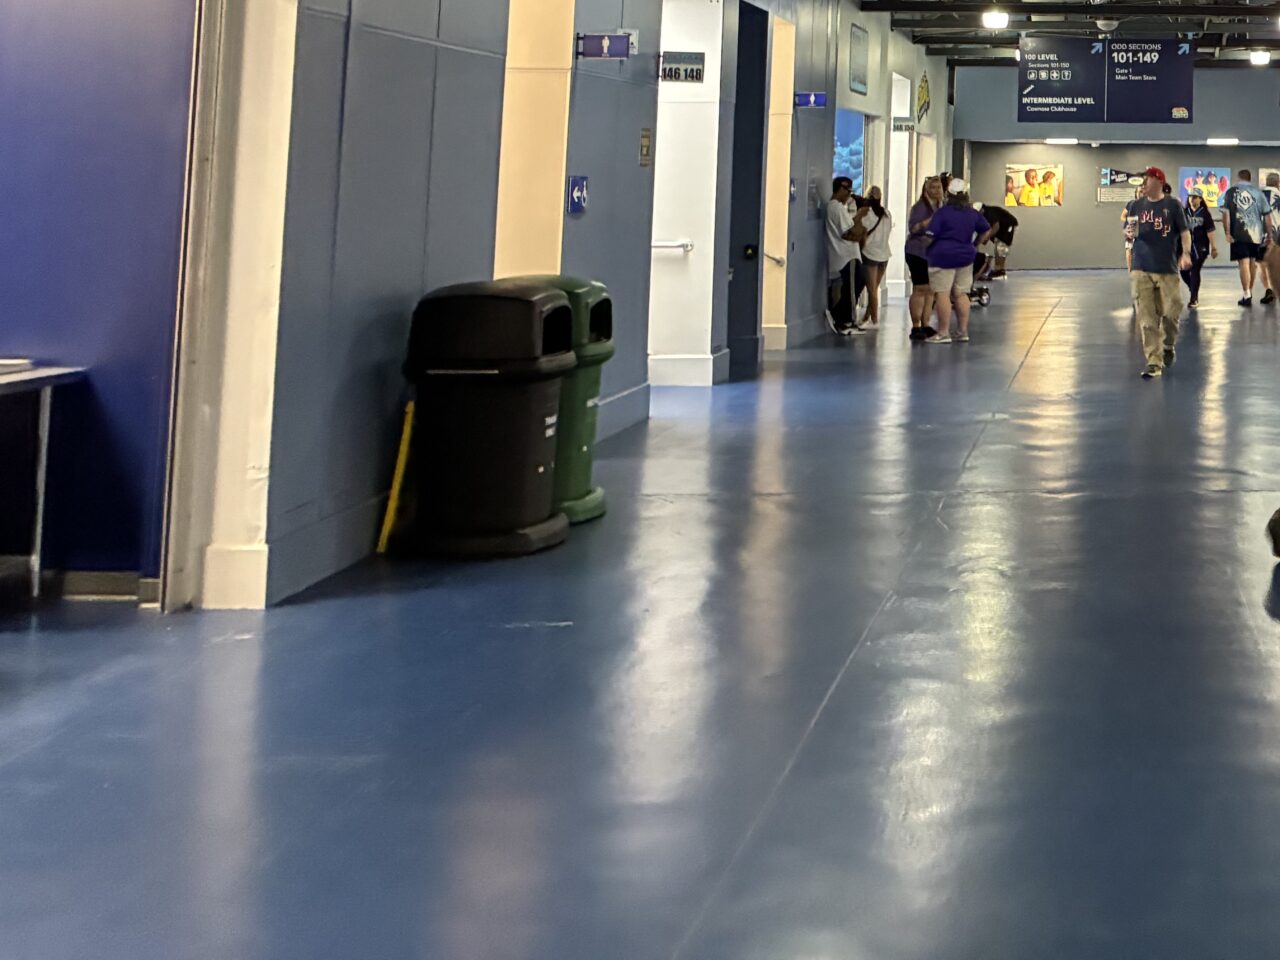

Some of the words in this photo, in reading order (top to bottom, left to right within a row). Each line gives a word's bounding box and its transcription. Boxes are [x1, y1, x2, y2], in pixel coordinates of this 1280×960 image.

[1111, 52, 1159, 63] 101-149
[662, 67, 680, 80] 146
[683, 68, 702, 81] 148
